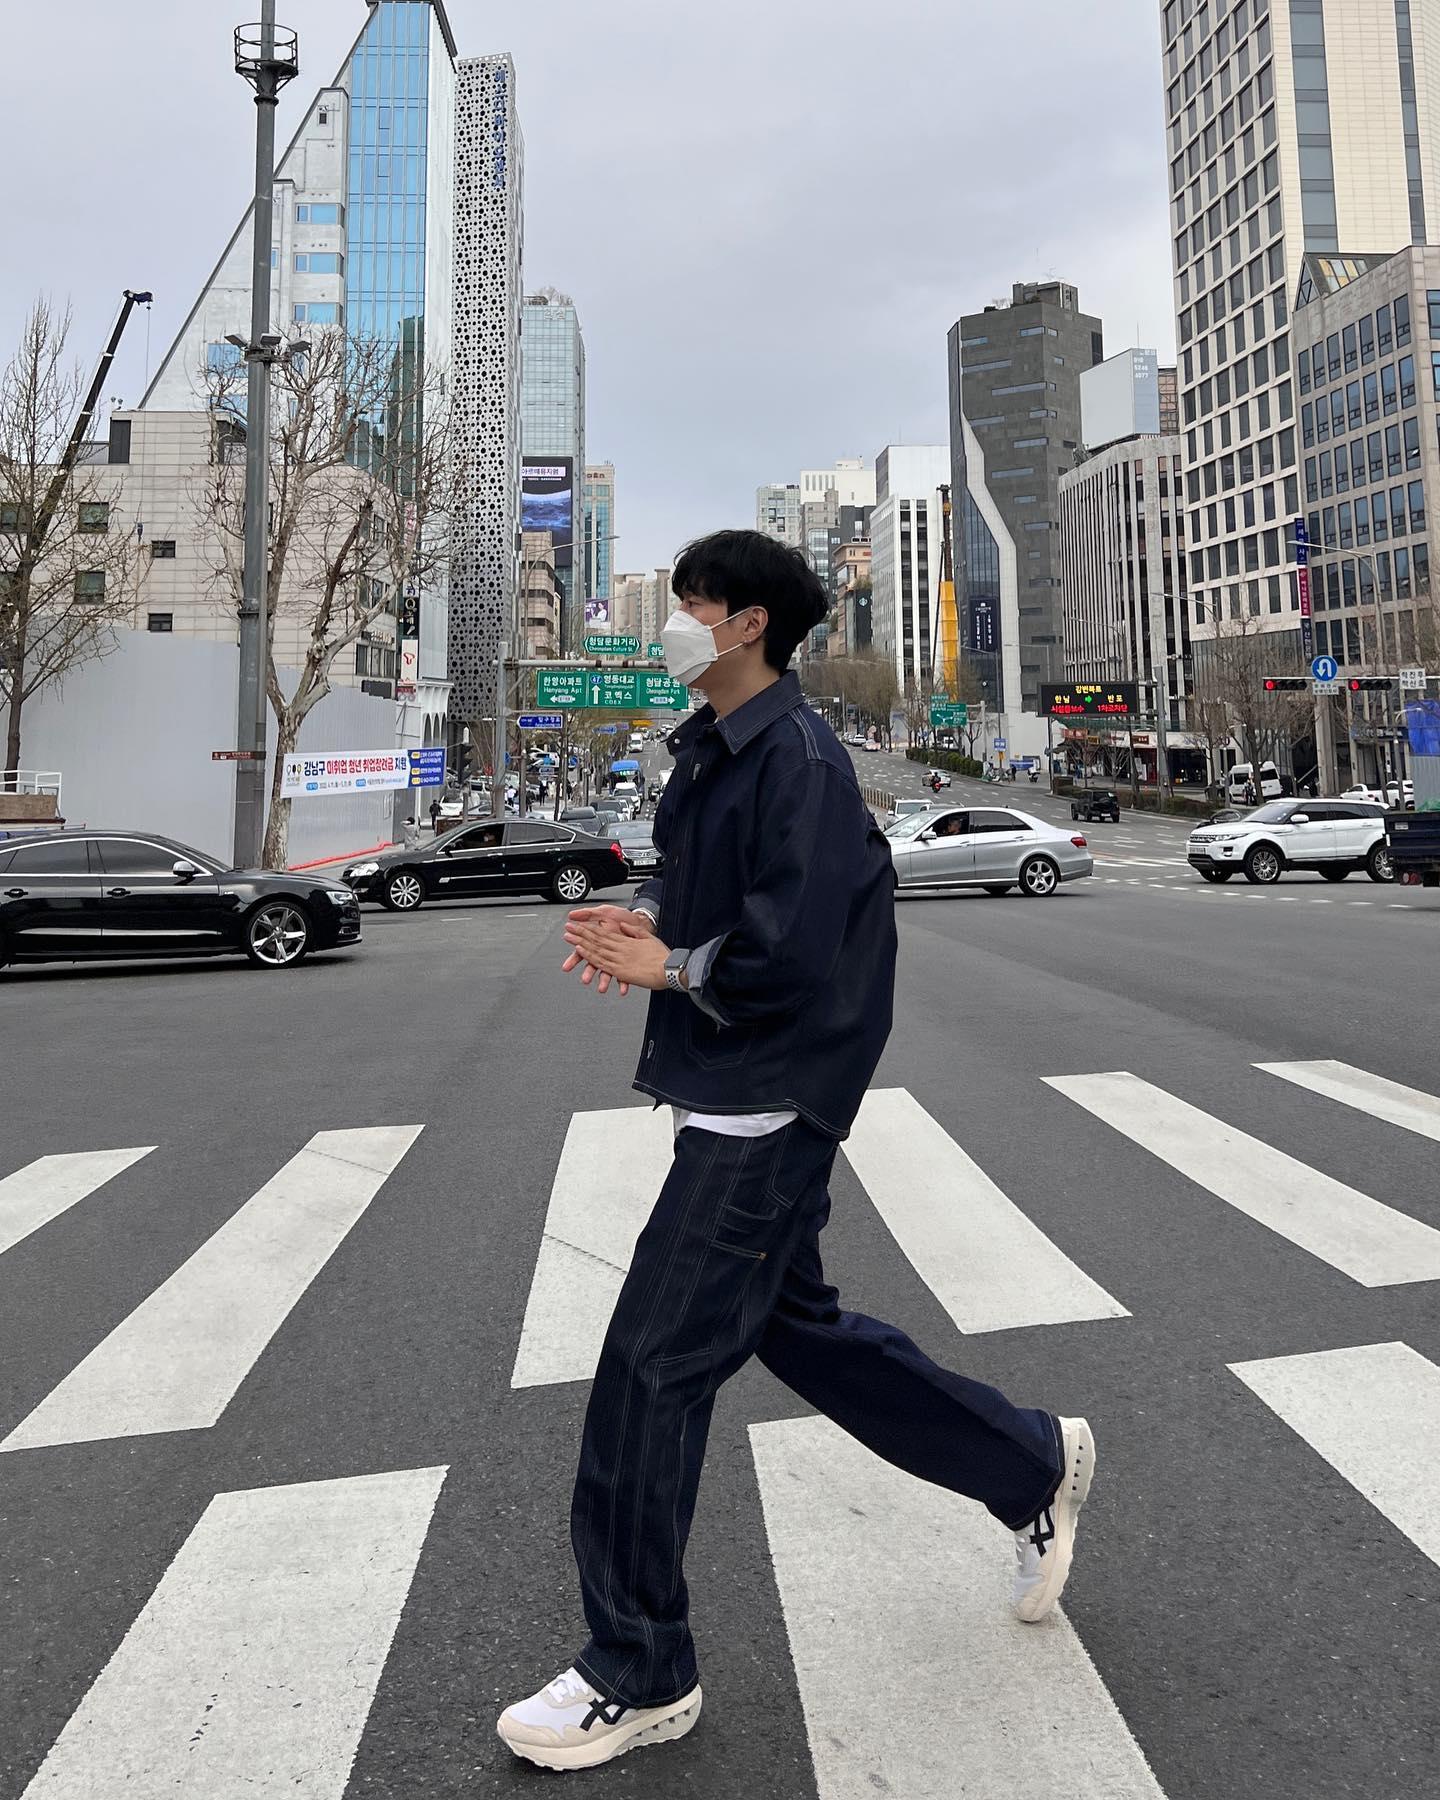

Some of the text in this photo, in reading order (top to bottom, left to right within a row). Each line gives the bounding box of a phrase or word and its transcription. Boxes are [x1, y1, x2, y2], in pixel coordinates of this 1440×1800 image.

[589, 636, 636, 646] 청담문화거리
[543, 676, 583, 686] 한양아파트
[603, 674, 635, 684] 영동대교
[646, 677, 680, 688] 청담공원
[304, 760, 326, 777] 강남구
[326, 759, 348, 775] 미취업
[348, 759, 362, 774] 청년
[362, 757, 394, 773] 취업장려금
[394, 756, 407, 771] 지원
